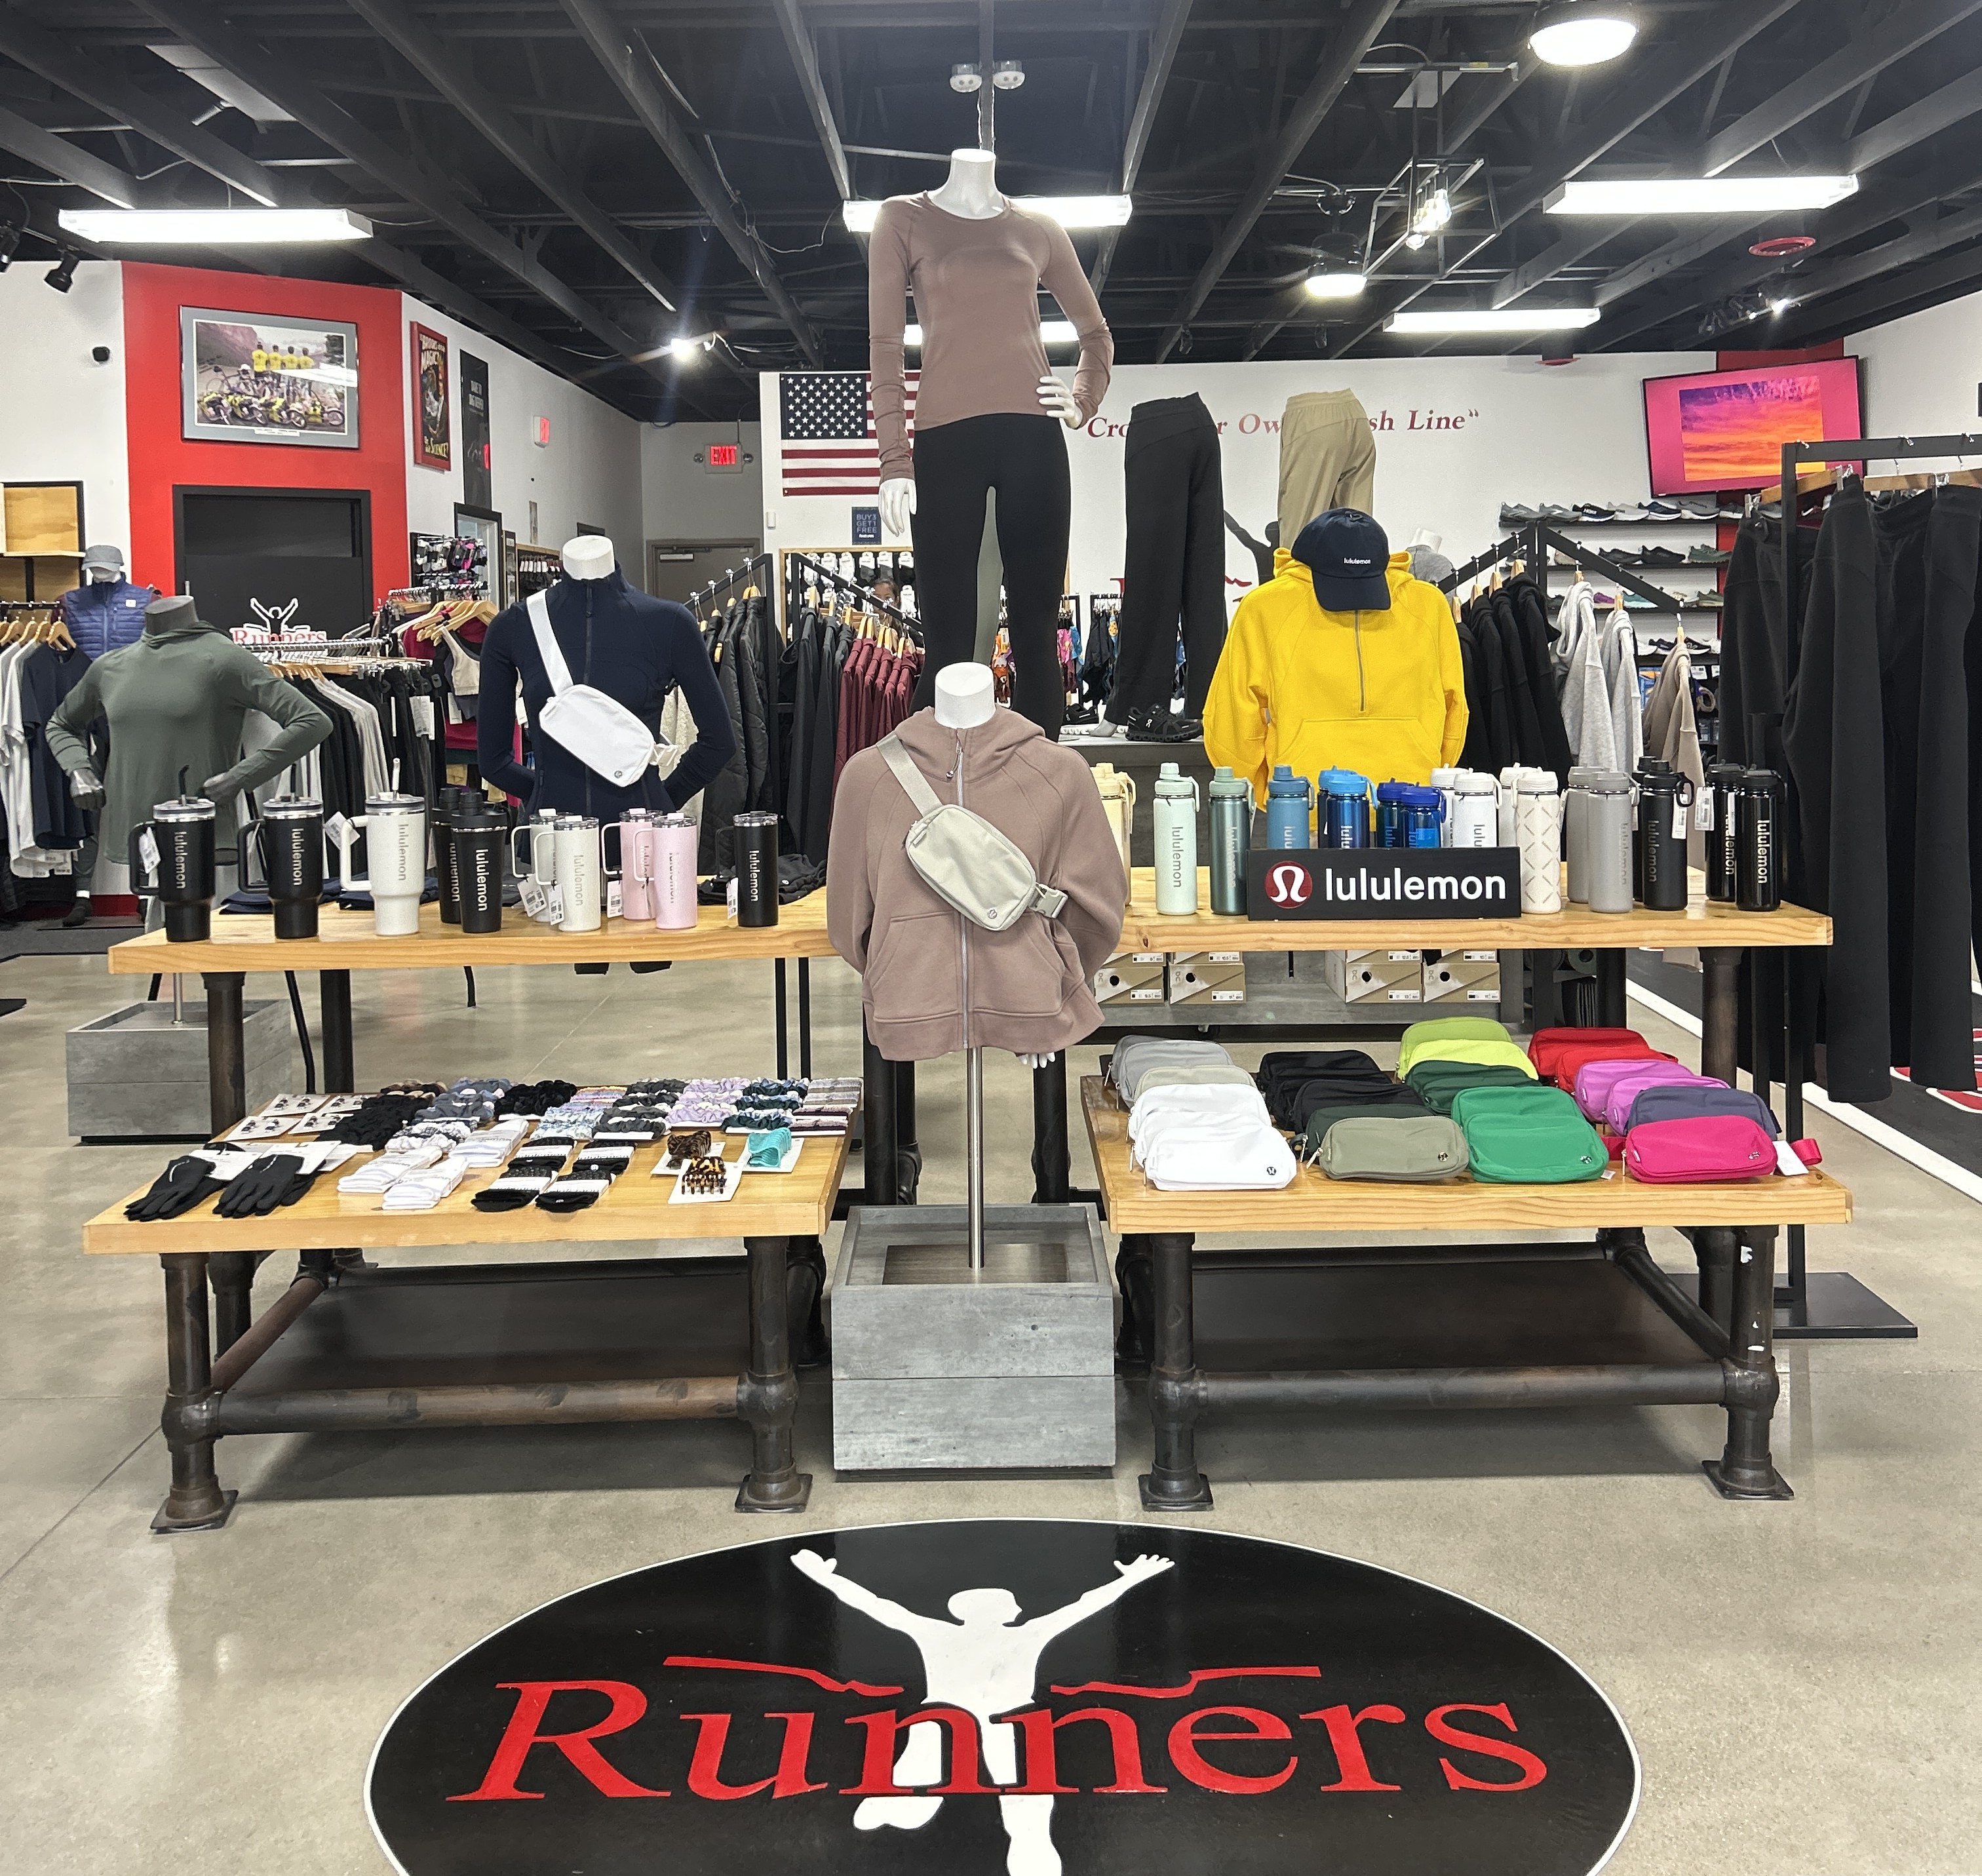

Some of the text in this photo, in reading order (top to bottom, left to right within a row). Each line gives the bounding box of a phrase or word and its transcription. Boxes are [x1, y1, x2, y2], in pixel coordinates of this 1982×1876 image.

[1238, 413, 1281, 435] Ow
[710, 446, 737, 465] EXIT
[233, 629, 326, 643] Runners
[174, 831, 189, 889] lululemon
[291, 828, 305, 886] lululemon
[398, 823, 409, 881] lululemon
[475, 849, 490, 911] lululemon
[749, 850, 760, 902] lululemon
[1171, 826, 1184, 888] lululemon
[1648, 820, 1660, 882] lululemon
[1757, 819, 1770, 884] lululemon
[573, 855, 585, 906] lululemon
[1325, 867, 1506, 901] lululemon
[445, 1680, 1547, 1802] Runners
